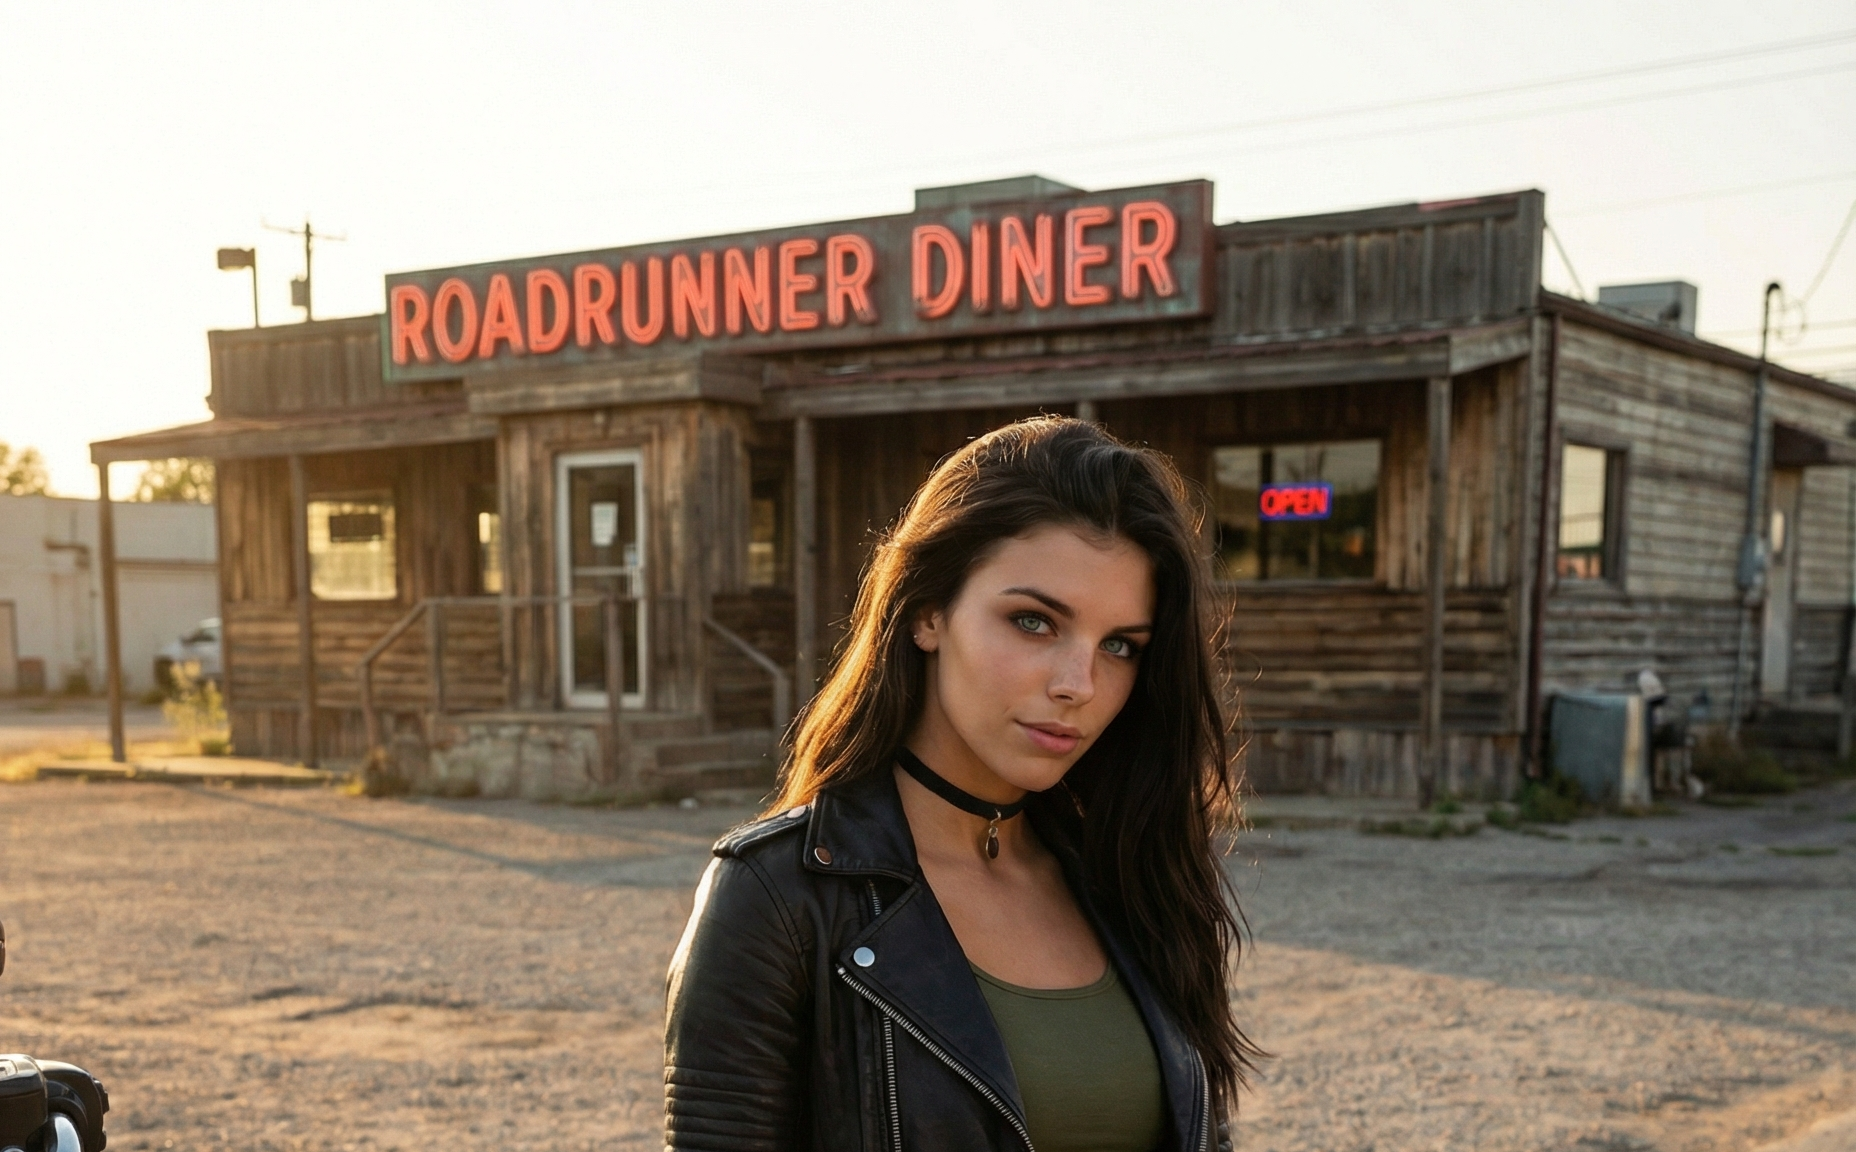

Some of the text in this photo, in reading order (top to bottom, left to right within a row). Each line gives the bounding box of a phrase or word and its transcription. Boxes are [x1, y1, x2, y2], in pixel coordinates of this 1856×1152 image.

[390, 200, 1178, 365] ROADRUNNER DINER
[1260, 487, 1329, 517] OPEN
